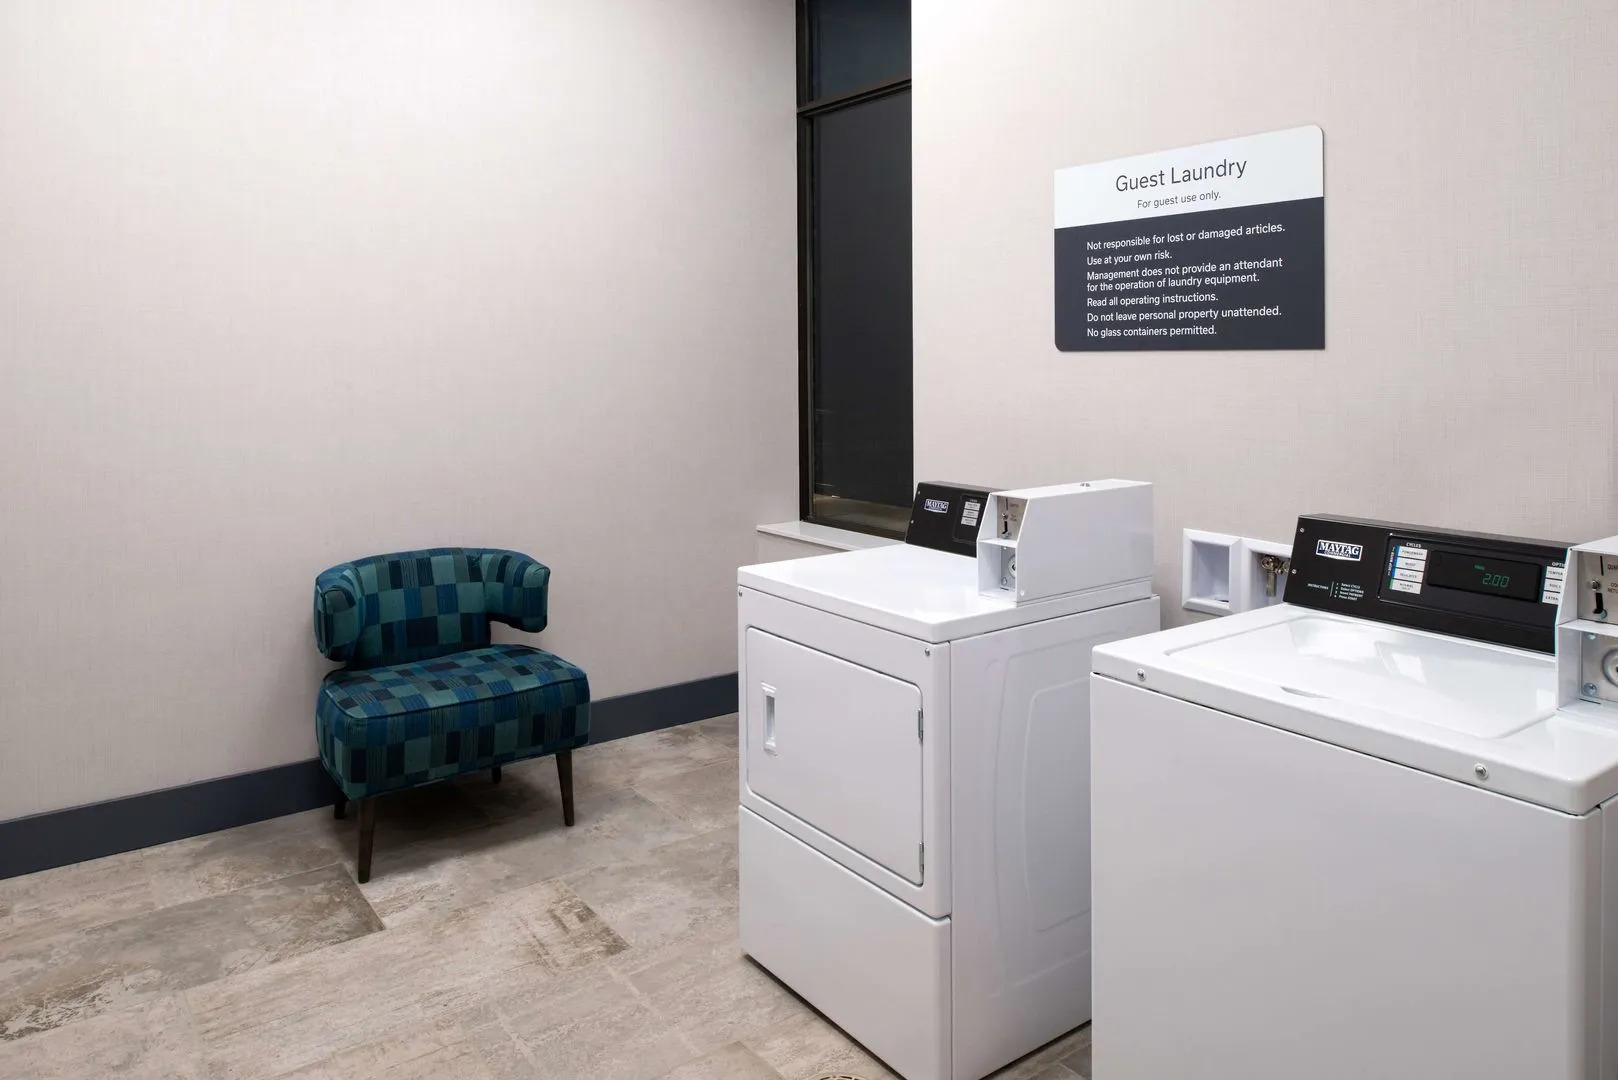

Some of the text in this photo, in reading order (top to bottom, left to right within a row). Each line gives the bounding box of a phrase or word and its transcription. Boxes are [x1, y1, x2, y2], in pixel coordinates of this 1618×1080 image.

[1115, 158, 1248, 192] Guest Laundry
[1137, 189, 1222, 209] For guest use only.
[1086, 222, 1286, 251] Not responsible for lost or damaged articles.
[1086, 249, 1173, 266] Use at your own risk.
[1086, 257, 1283, 281] Management does not provide an attendant
[1086, 272, 1260, 292] for the operation of laundry equipment.
[1086, 291, 1219, 307] Read all operating instructions.
[1086, 305, 1282, 322] Do not leave personal property unattended.
[1086, 324, 1217, 339] No glass containers permitted.
[925, 499, 948, 510] MAYTAG
[1319, 541, 1360, 556] MAYTAG
[1482, 572, 1511, 588] 2.00
